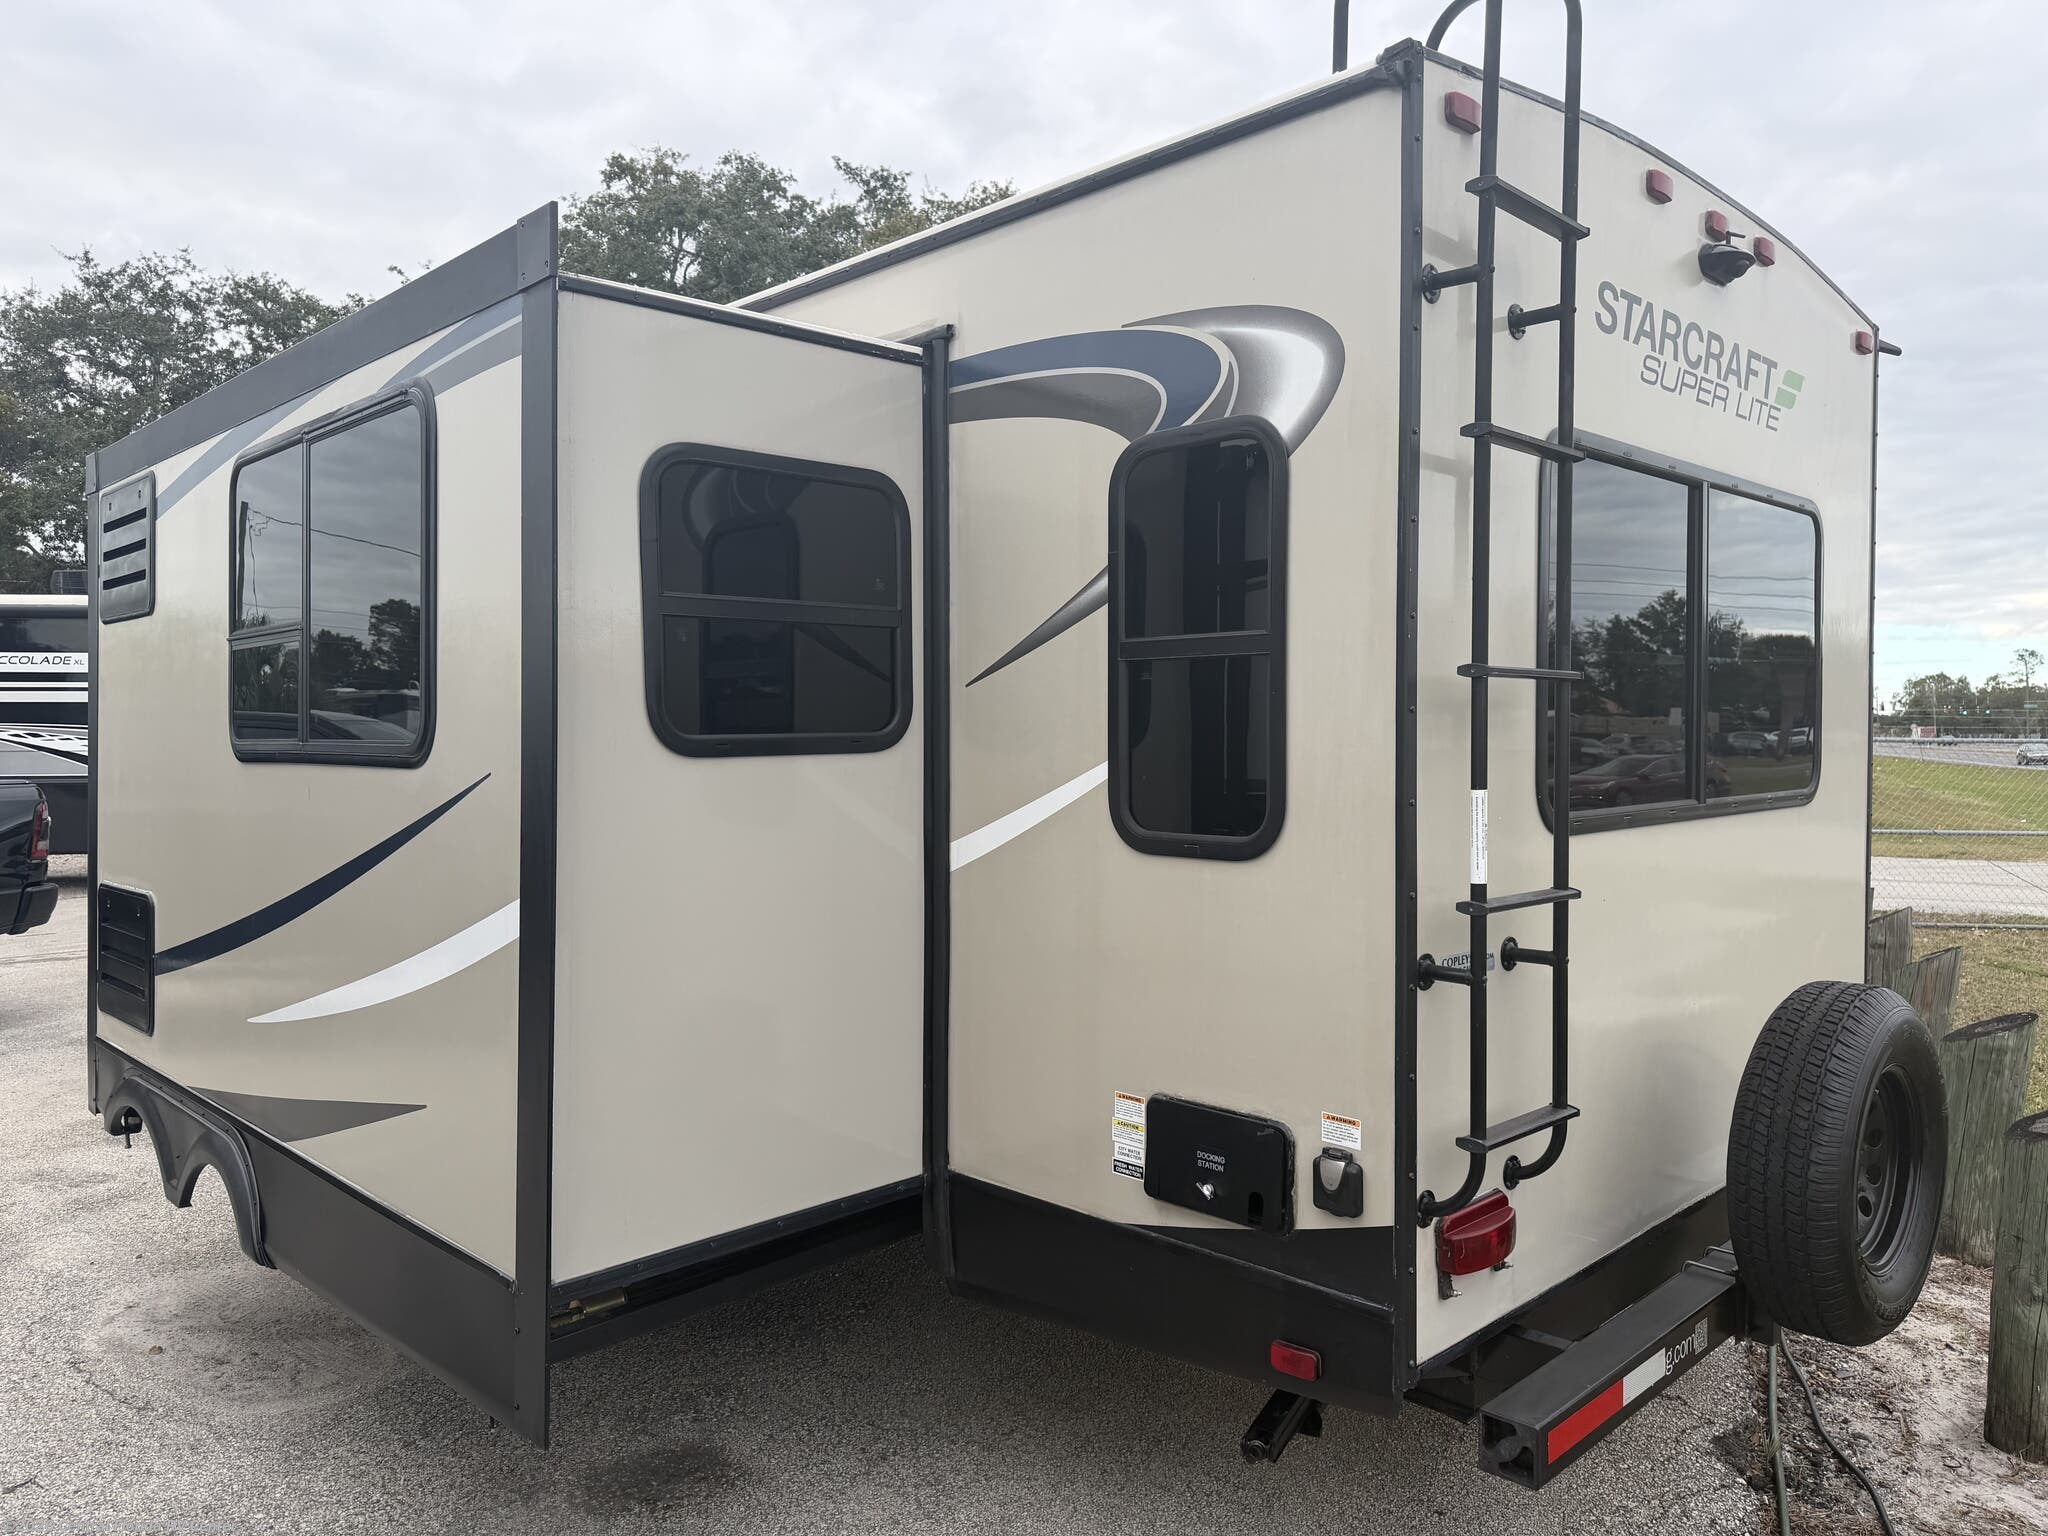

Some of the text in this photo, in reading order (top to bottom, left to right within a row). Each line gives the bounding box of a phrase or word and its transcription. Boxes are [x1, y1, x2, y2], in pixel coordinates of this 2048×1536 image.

[1594, 280, 1777, 400] STARCRAFT
[1640, 354, 1781, 432] SUPER LITE
[1330, 1115, 1356, 1125] WARNING
[1197, 1150, 1225, 1164] DOCKING
[1198, 1159, 1224, 1172] STATION
